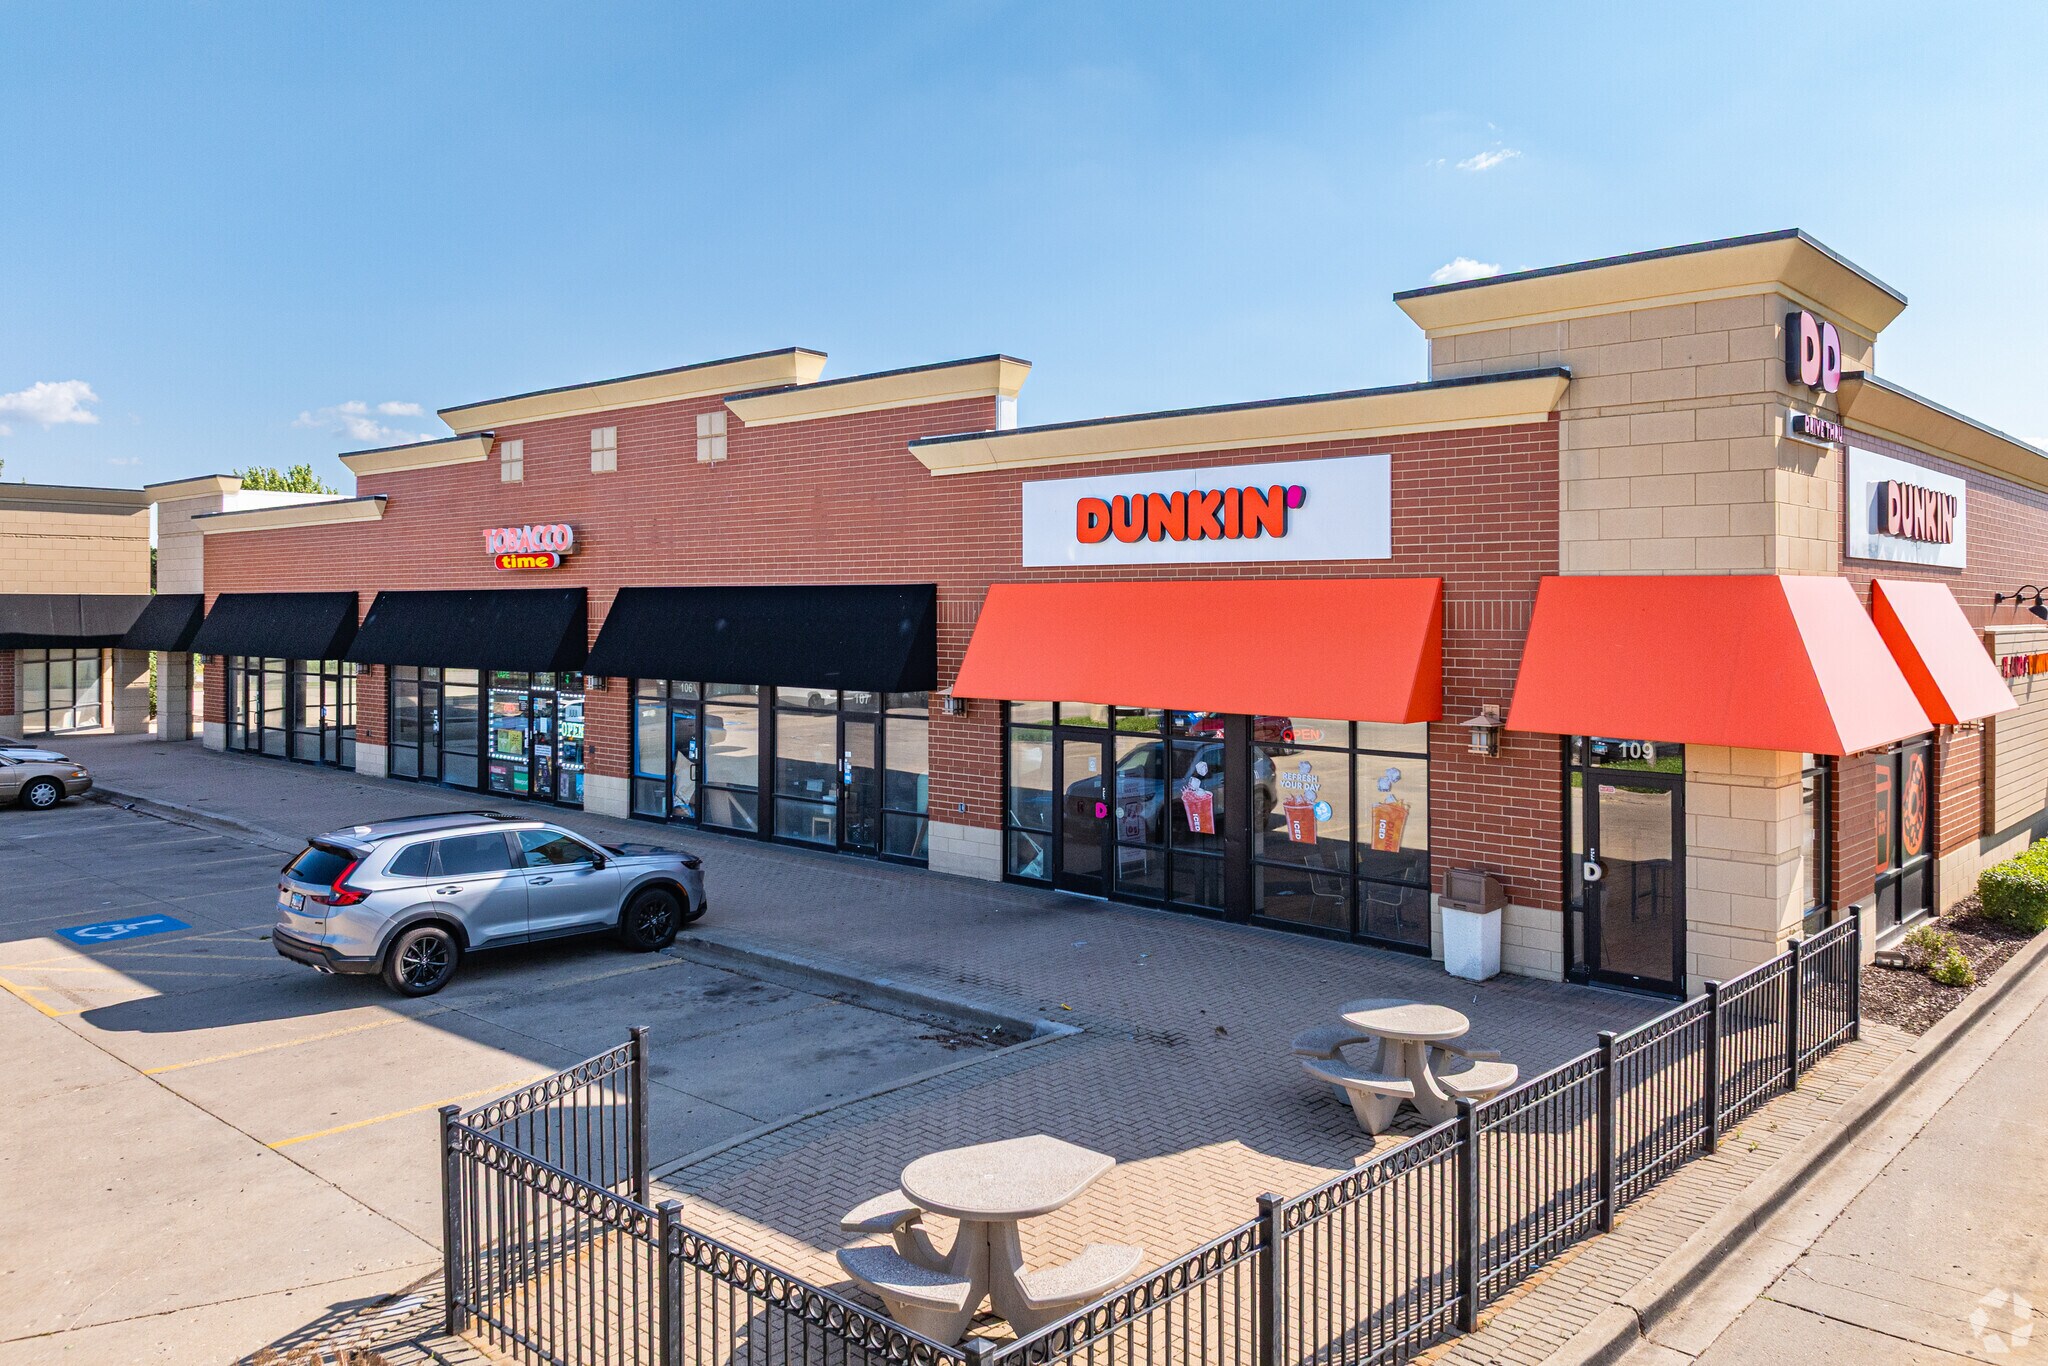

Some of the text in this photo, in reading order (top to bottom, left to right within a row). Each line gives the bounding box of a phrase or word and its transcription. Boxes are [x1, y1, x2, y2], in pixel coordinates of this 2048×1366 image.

[1799, 310, 1842, 394] DD
[1804, 415, 1825, 438] DRIVE
[1076, 485, 1306, 544] DUNKIN'
[1887, 479, 1958, 544] DUNKIN'
[483, 524, 572, 554] TOBACCO
[502, 554, 549, 569] time
[681, 683, 693, 693] 106
[854, 693, 869, 705] 107
[1283, 728, 1321, 741] OPEN
[1618, 741, 1654, 760] 109
[1280, 780, 1321, 792] YOUR DAY
[1282, 772, 1318, 783] REFRESH
[1192, 813, 1200, 832] ICED
[1293, 820, 1302, 840] ICED
[1379, 819, 1387, 840] ICED
[1583, 861, 1602, 881] D
